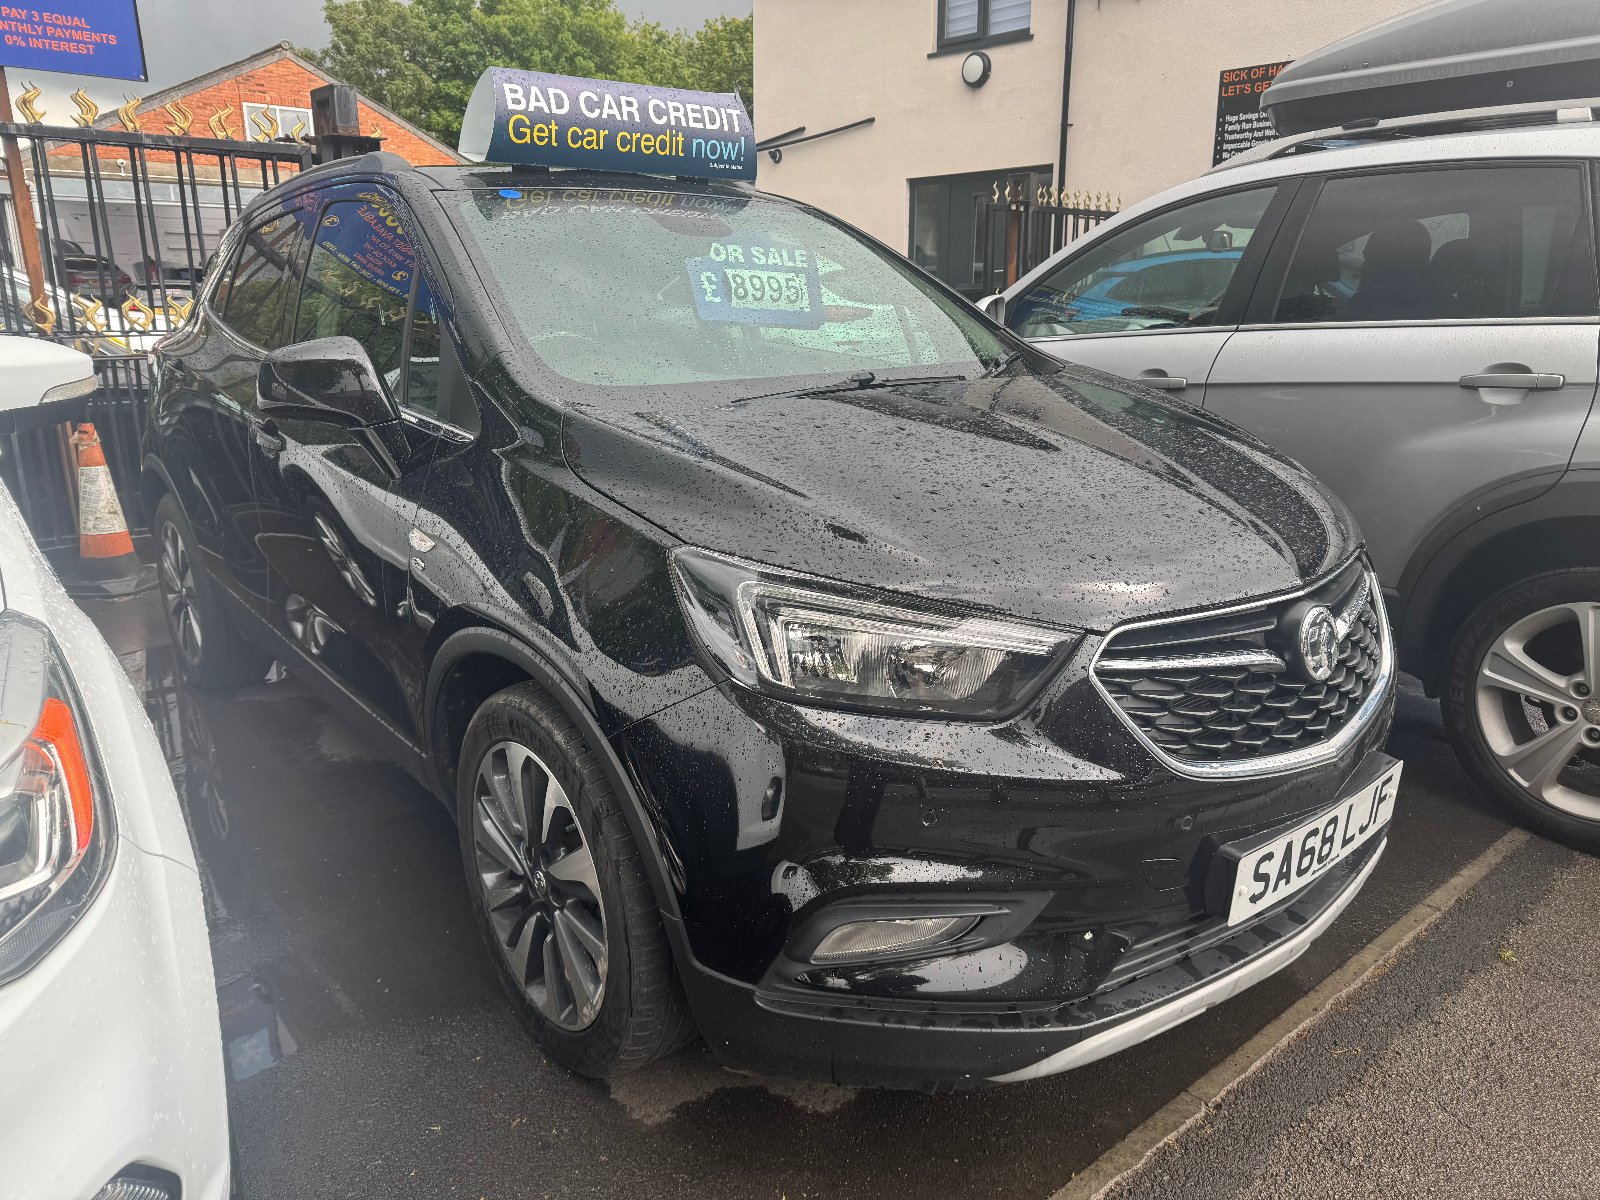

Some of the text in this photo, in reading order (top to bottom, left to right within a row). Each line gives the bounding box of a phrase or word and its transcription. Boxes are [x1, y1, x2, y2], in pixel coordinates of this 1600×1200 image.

[1, 6, 90, 29] PAY 3 EQUAL
[4, 34, 95, 55] 0% INTEREST
[46, 26, 117, 45] PAYMENTS
[1223, 69, 1248, 83] SICK
[1250, 67, 1266, 79] OF
[1221, 80, 1272, 97] LET'S GE
[503, 82, 741, 133] BAD CAR CREDIT
[508, 113, 745, 161] Get car credit now!
[1225, 122, 1241, 132] Family
[750, 245, 810, 268] SALE
[700, 271, 800, 304] £ 8995
[1249, 774, 1394, 904] SA68 LJF
